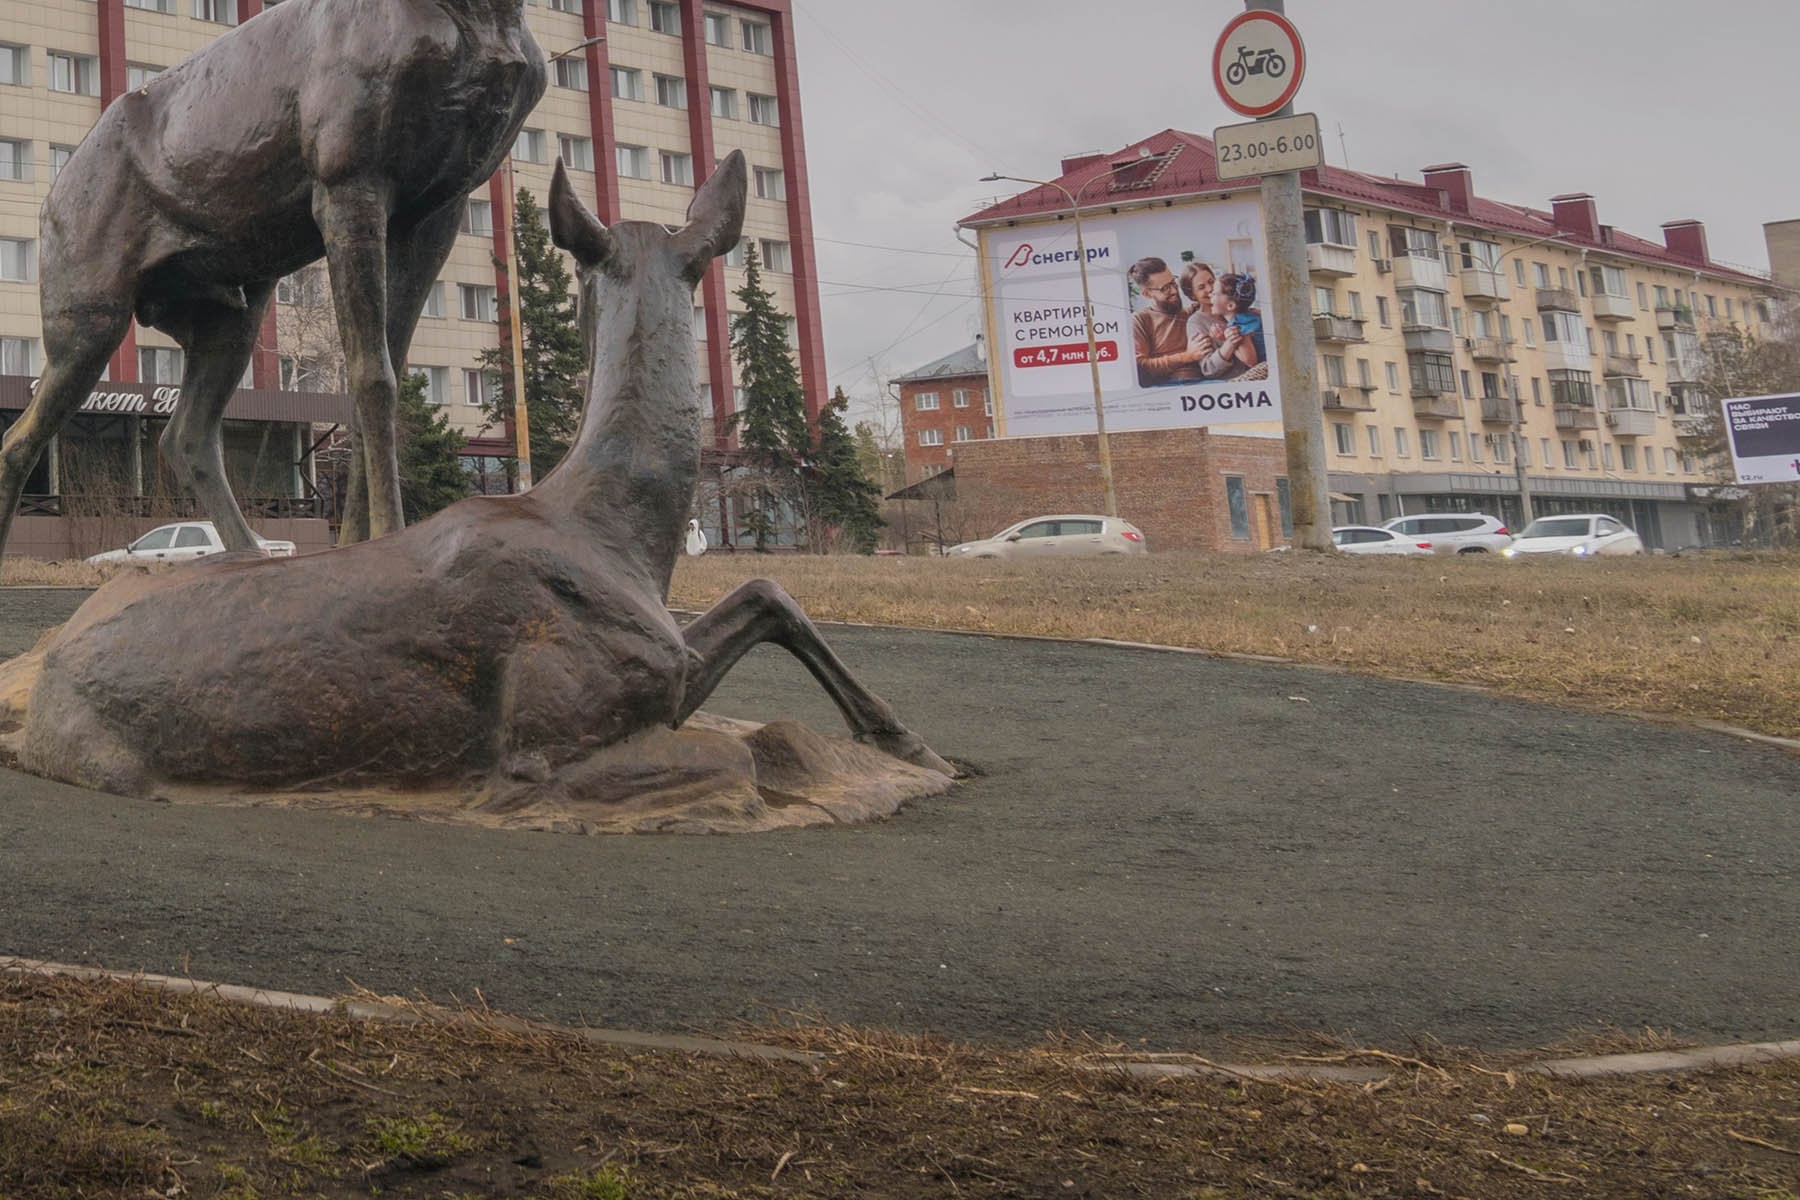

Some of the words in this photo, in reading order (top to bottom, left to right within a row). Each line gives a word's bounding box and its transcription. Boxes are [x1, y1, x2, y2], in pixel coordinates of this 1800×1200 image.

[1220, 134, 1314, 162] 23.00-6.00
[1013, 305, 1095, 324] КВАРТИРЫ
[1015, 329, 1026, 341] С
[1020, 355, 1034, 364] от
[1036, 348, 1058, 364] 4,7
[1061, 352, 1084, 361] млн
[1180, 390, 1273, 412] DOGMA
